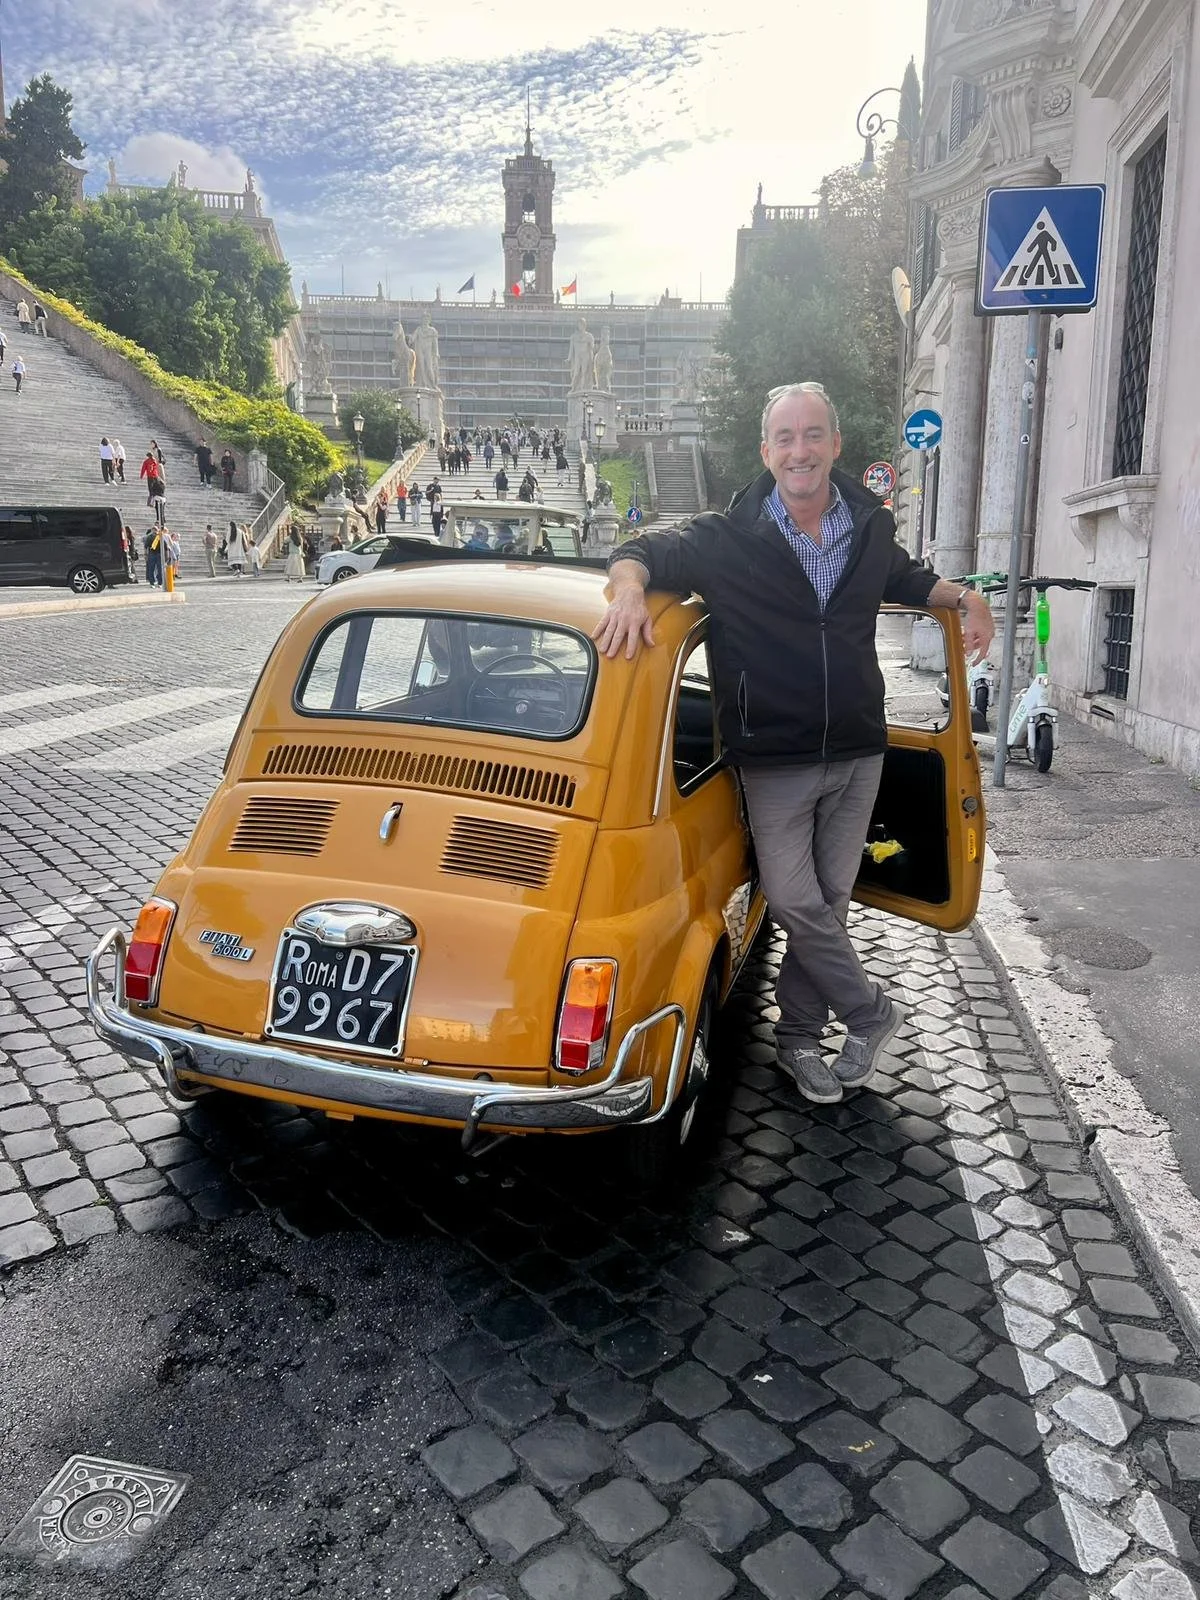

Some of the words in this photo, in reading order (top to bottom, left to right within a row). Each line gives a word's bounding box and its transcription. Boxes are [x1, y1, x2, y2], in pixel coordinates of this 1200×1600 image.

[200, 931, 238, 946] FIAT
[341, 948, 405, 995] D7
[273, 985, 393, 1044] 9967
[73, 1476, 150, 1509] ARRESTO
